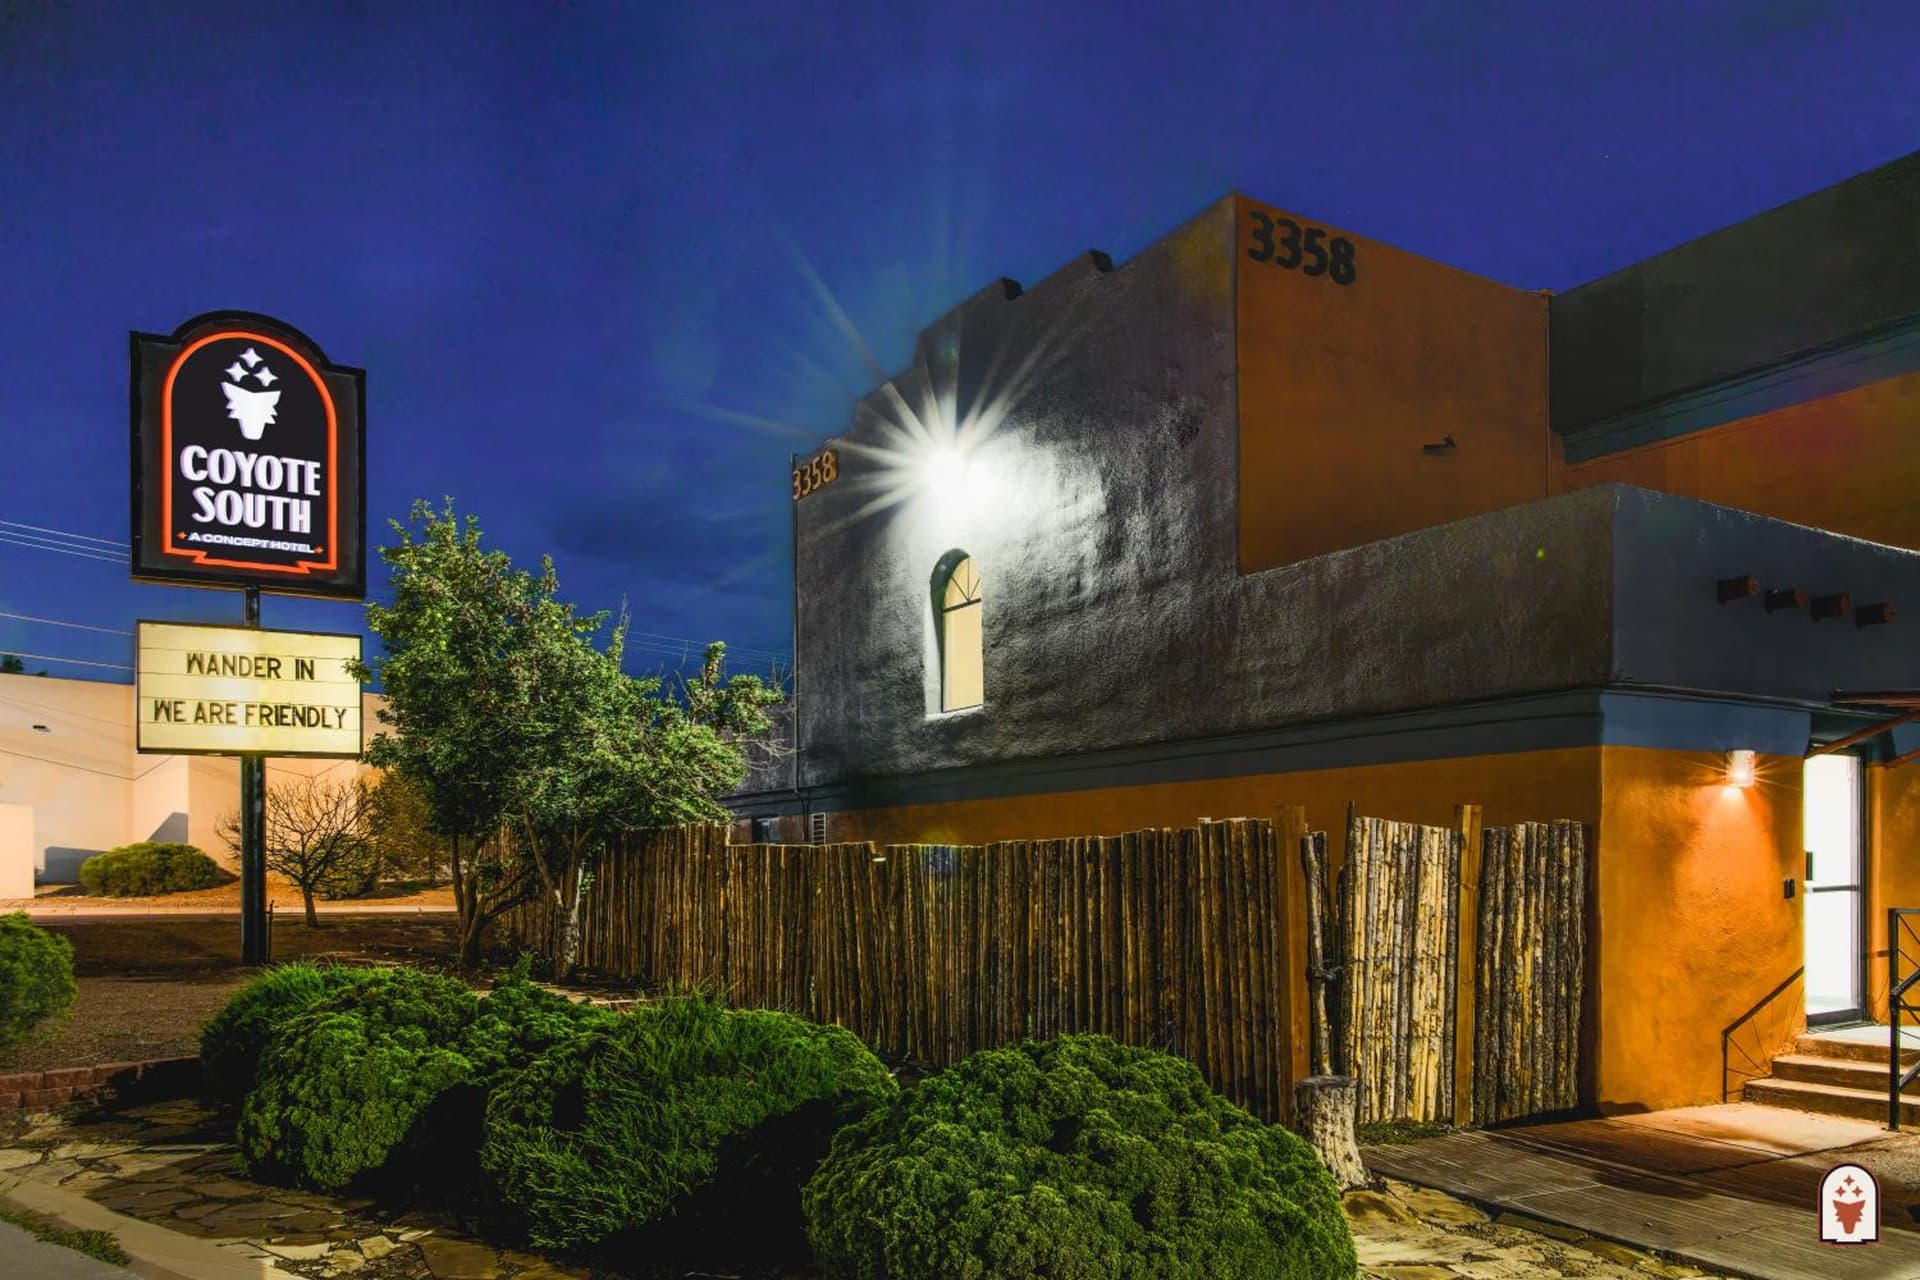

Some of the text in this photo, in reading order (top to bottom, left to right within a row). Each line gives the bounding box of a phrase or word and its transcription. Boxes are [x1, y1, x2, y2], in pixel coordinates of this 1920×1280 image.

[1248, 210, 1356, 285] 3358
[180, 444, 321, 496] COYOTE
[792, 448, 837, 500] 3358
[192, 486, 311, 534] SOUTH
[187, 532, 316, 554] A CONCEPT HOTEL
[186, 652, 315, 680] WANDER IN
[154, 699, 347, 729] WE ARE FRIENDLY
